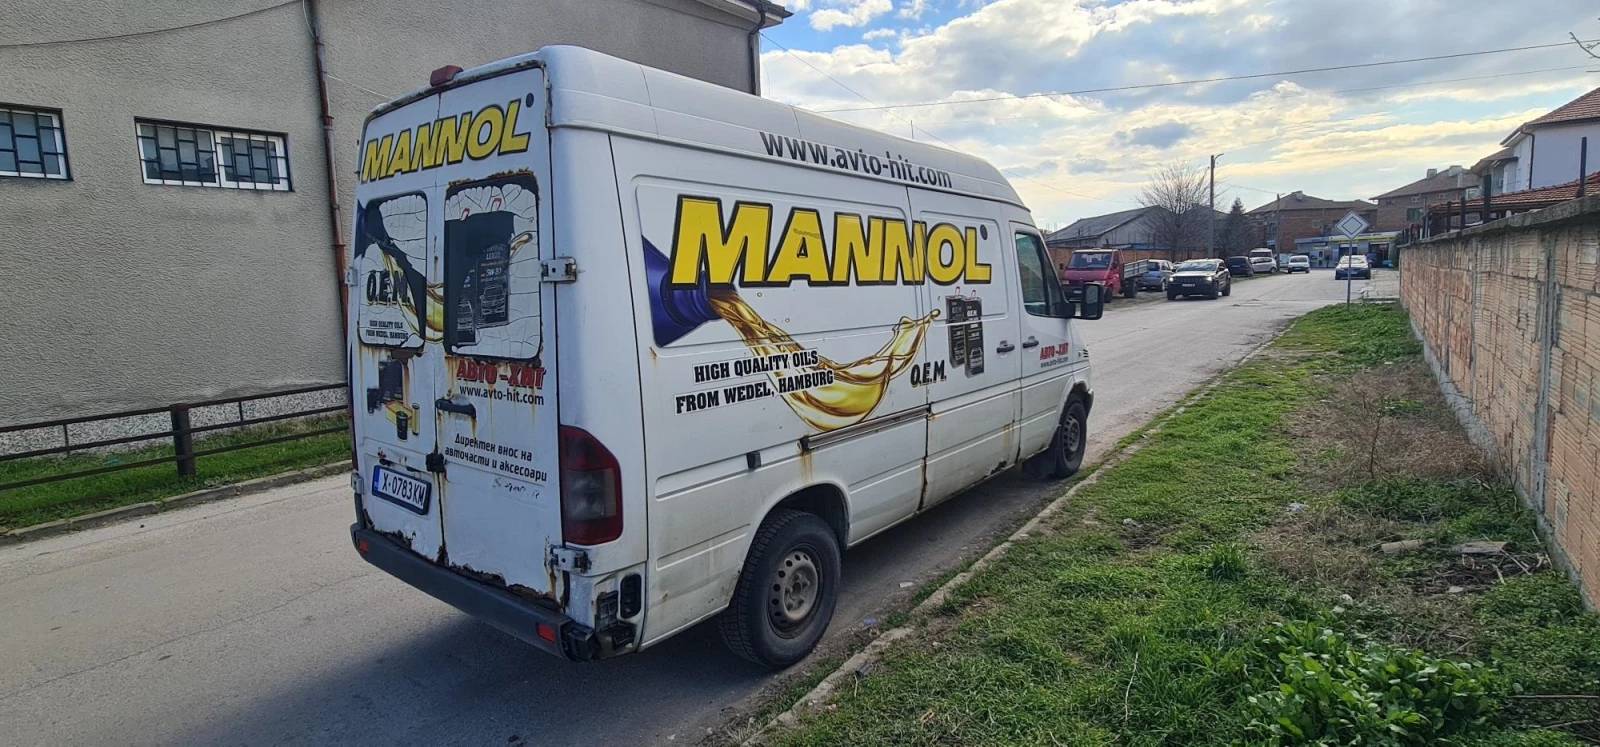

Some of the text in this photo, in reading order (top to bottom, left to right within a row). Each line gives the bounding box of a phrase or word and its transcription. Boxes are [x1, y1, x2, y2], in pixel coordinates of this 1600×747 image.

[361, 98, 531, 184] MANNOL
[759, 131, 953, 189] www.avto-hit.com
[669, 193, 992, 290] MANNOL
[694, 350, 819, 383] HIGH QUALITY OILS
[910, 360, 947, 388] O.E.M.
[459, 385, 544, 405] www.avto-hit.com
[675, 370, 834, 414] FROM WEDEL, HAMBURG
[445, 446, 548, 482] авточасти и аксесоари
[455, 433, 533, 462] Директен внос на
